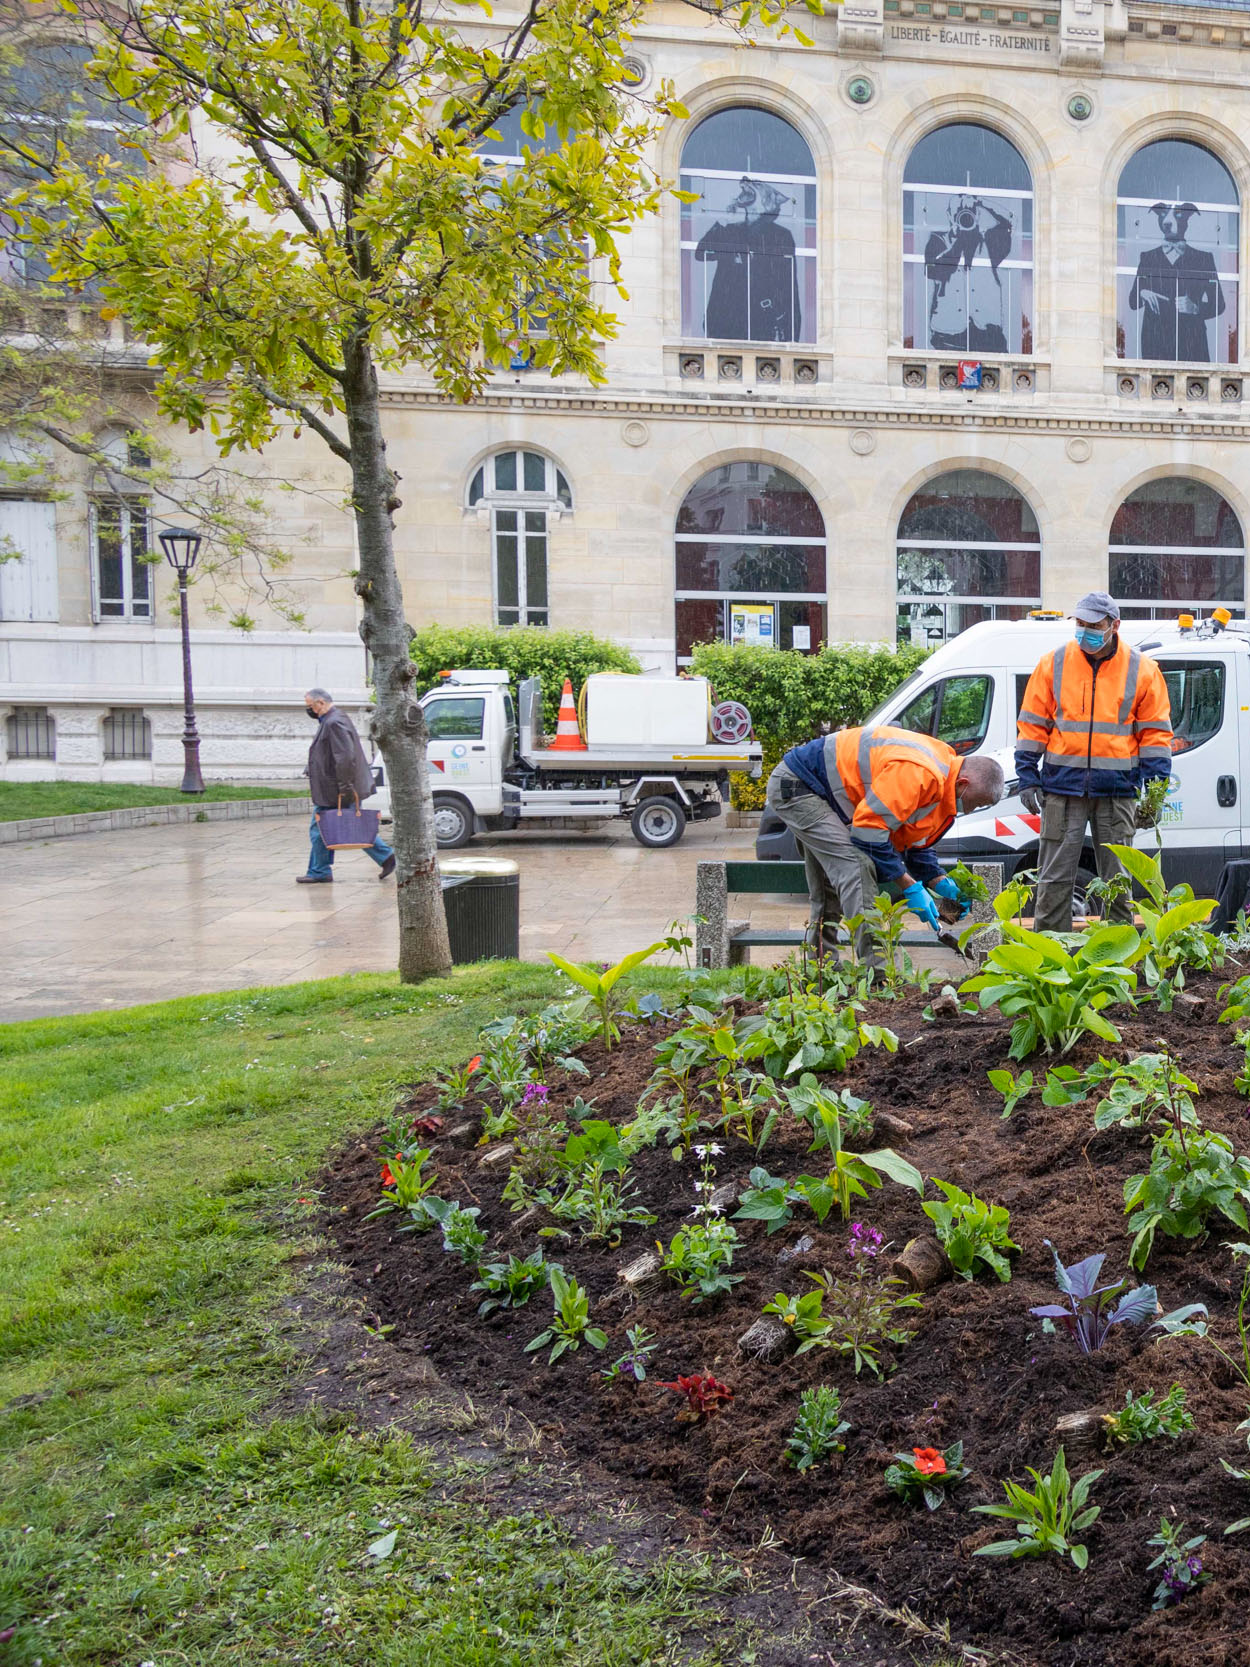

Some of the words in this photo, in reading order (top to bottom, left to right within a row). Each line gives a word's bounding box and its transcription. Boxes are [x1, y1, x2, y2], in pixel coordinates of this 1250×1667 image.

[891, 26, 931, 42] LIBERTÉ
[940, 27, 980, 46] ÉGALITÉ
[989, 35, 1050, 51] FRATERNITÉ
[1163, 801, 1184, 812] EINE
[1162, 812, 1184, 822] UEST
